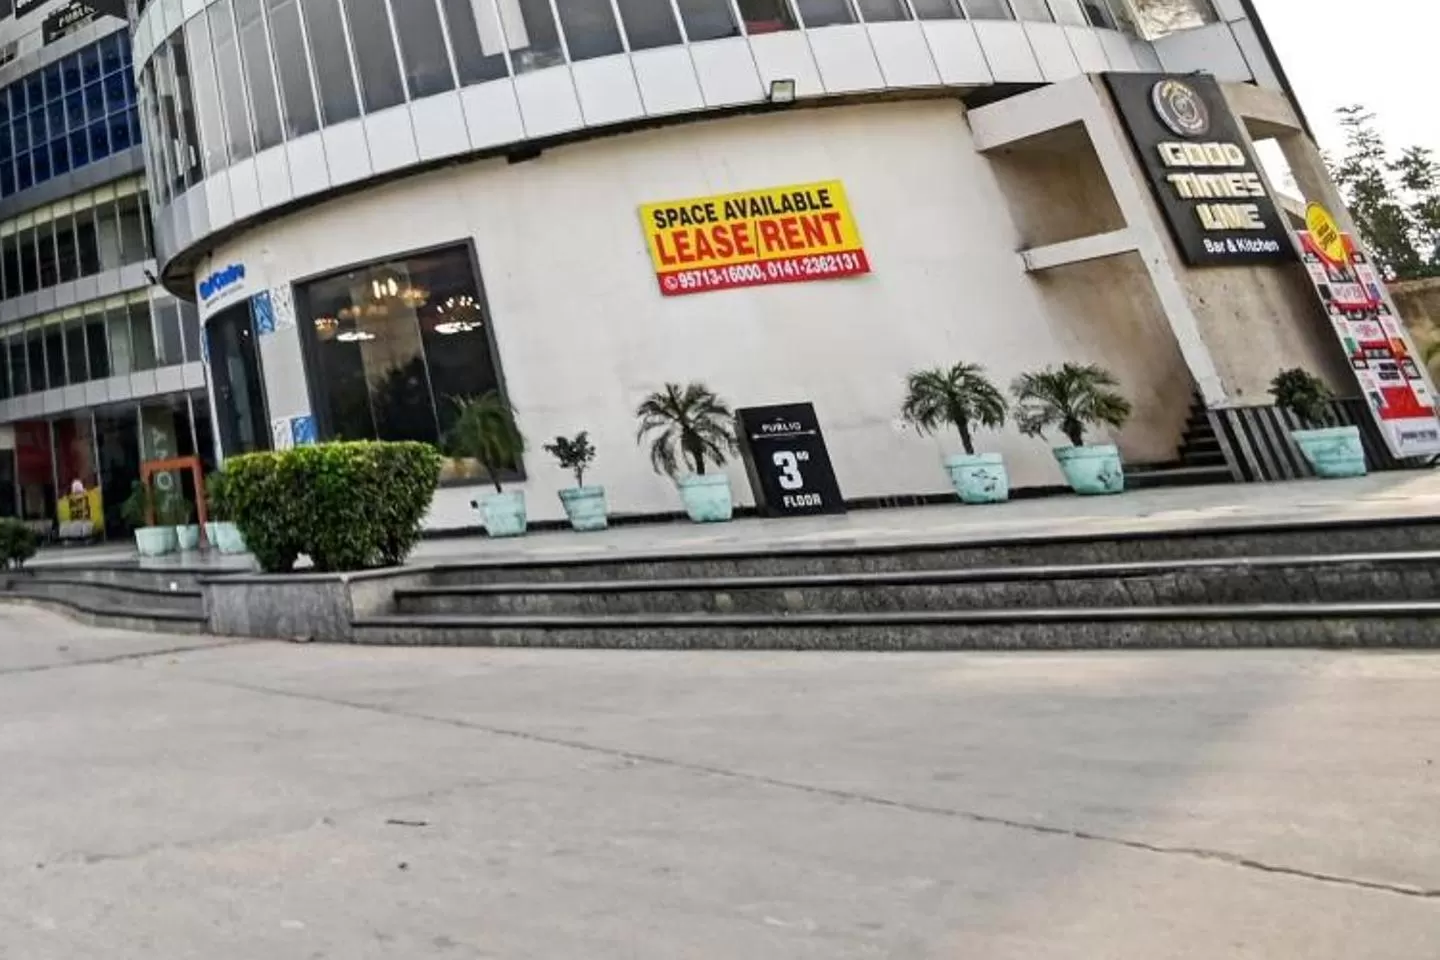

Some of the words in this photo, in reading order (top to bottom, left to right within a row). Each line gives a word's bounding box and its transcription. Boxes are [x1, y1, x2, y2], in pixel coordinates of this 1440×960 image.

[1158, 142, 1245, 167] GOOD
[1167, 172, 1266, 198] TIMES
[653, 203, 718, 229] SPACE
[725, 188, 833, 221] AVAILABLE
[654, 212, 845, 266] LEASE/RENT
[1203, 237, 1226, 253] Bar
[1226, 237, 1238, 252] &
[1236, 237, 1280, 252] Kitchen
[782, 493, 823, 508] FLOOR
